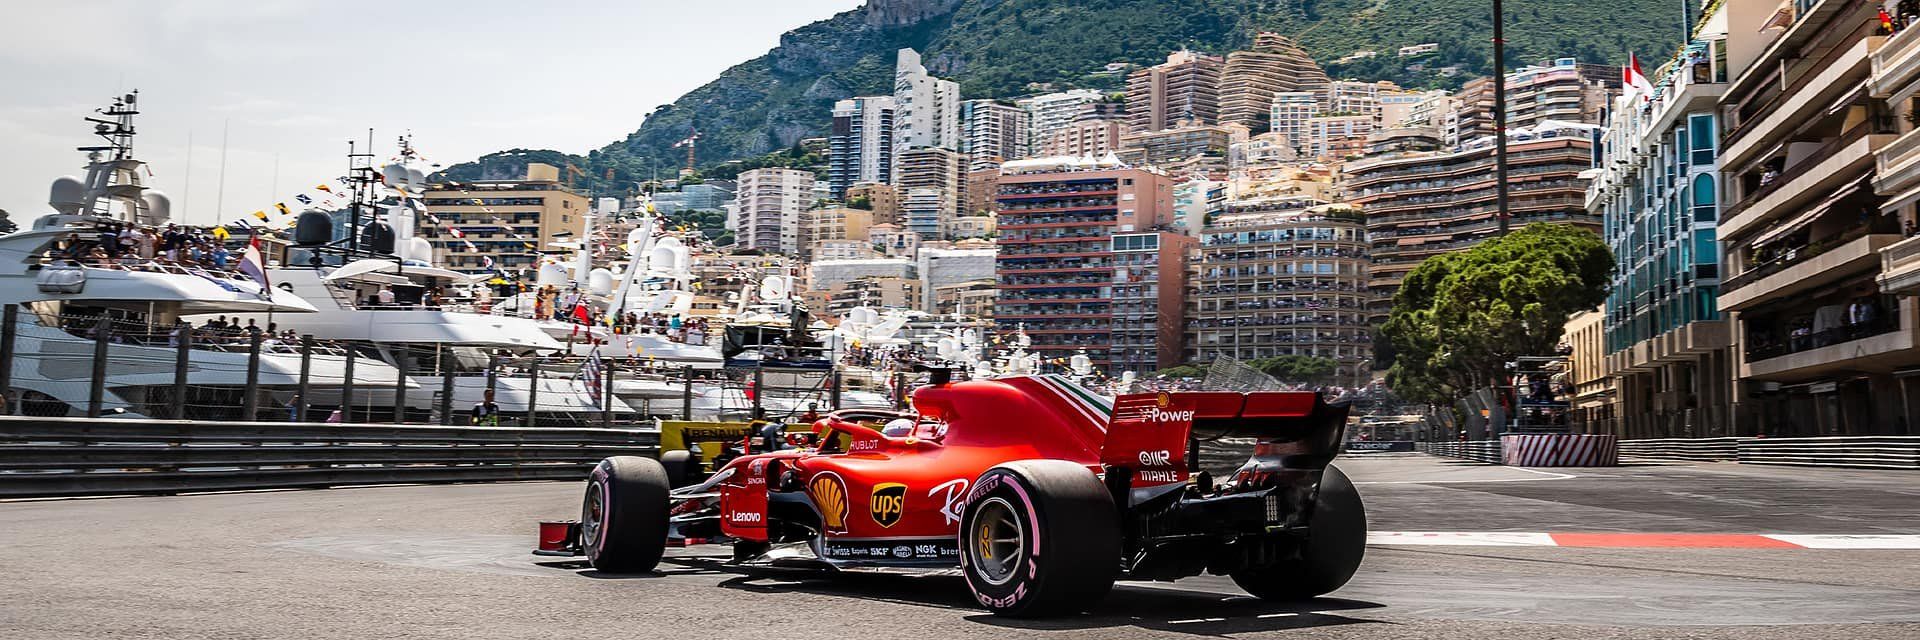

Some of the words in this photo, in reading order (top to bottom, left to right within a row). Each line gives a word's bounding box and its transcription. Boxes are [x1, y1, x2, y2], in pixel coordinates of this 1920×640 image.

[850, 439, 879, 450] HUBLOT
[1140, 470, 1178, 482] MAHLE
[873, 494, 902, 520] ups
[732, 510, 761, 522] Lenovo
[870, 547, 889, 556] SKF
[915, 544, 937, 554] NGK
[1028, 558, 1037, 579] P
[978, 580, 1028, 607] ZERO
